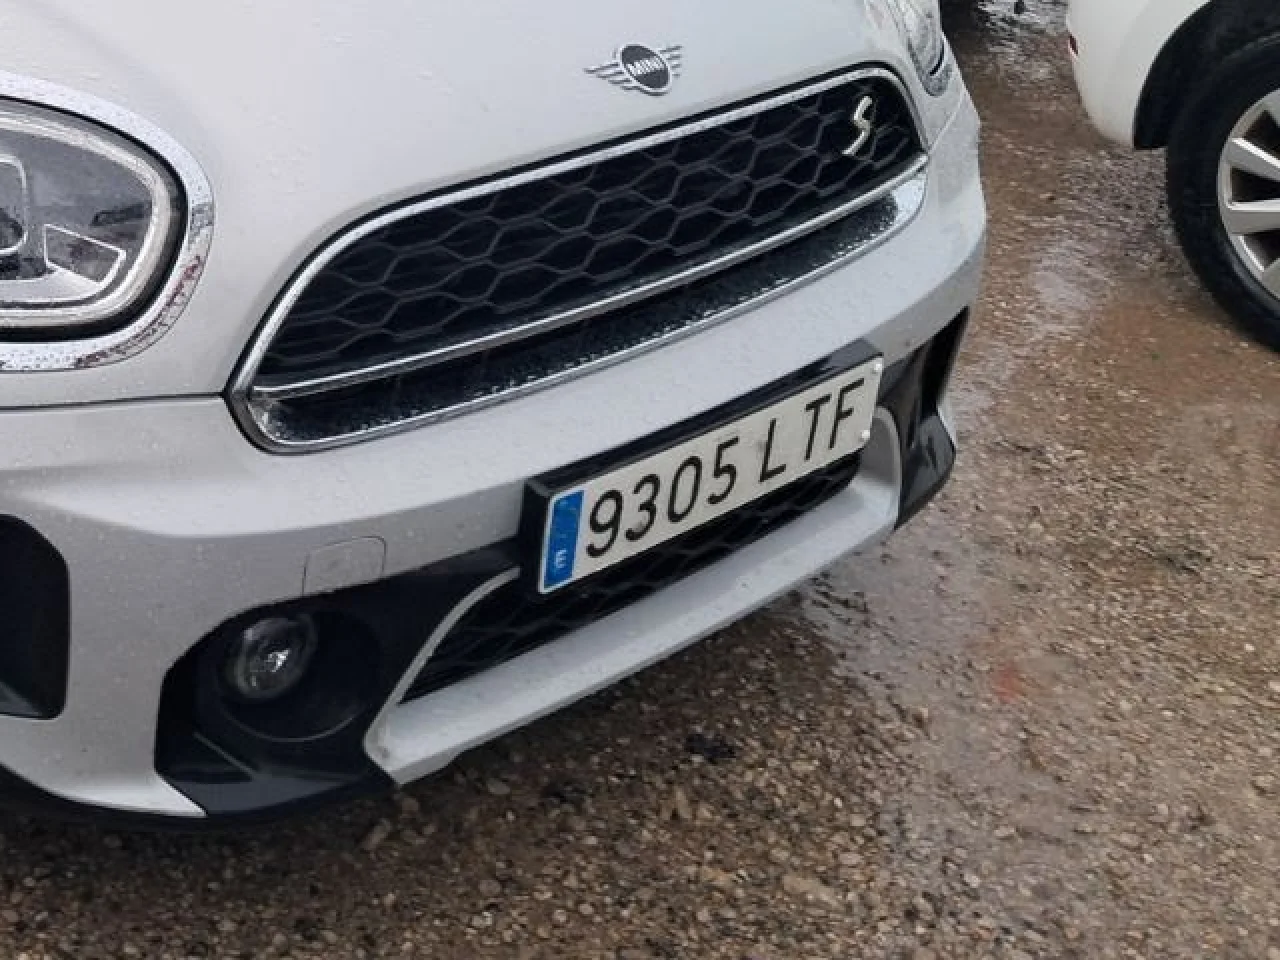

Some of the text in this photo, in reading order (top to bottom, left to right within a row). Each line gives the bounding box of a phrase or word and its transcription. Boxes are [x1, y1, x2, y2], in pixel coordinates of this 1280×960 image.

[842, 95, 873, 157] S
[586, 377, 866, 558] 9305 LTF
[554, 548, 568, 569] E
